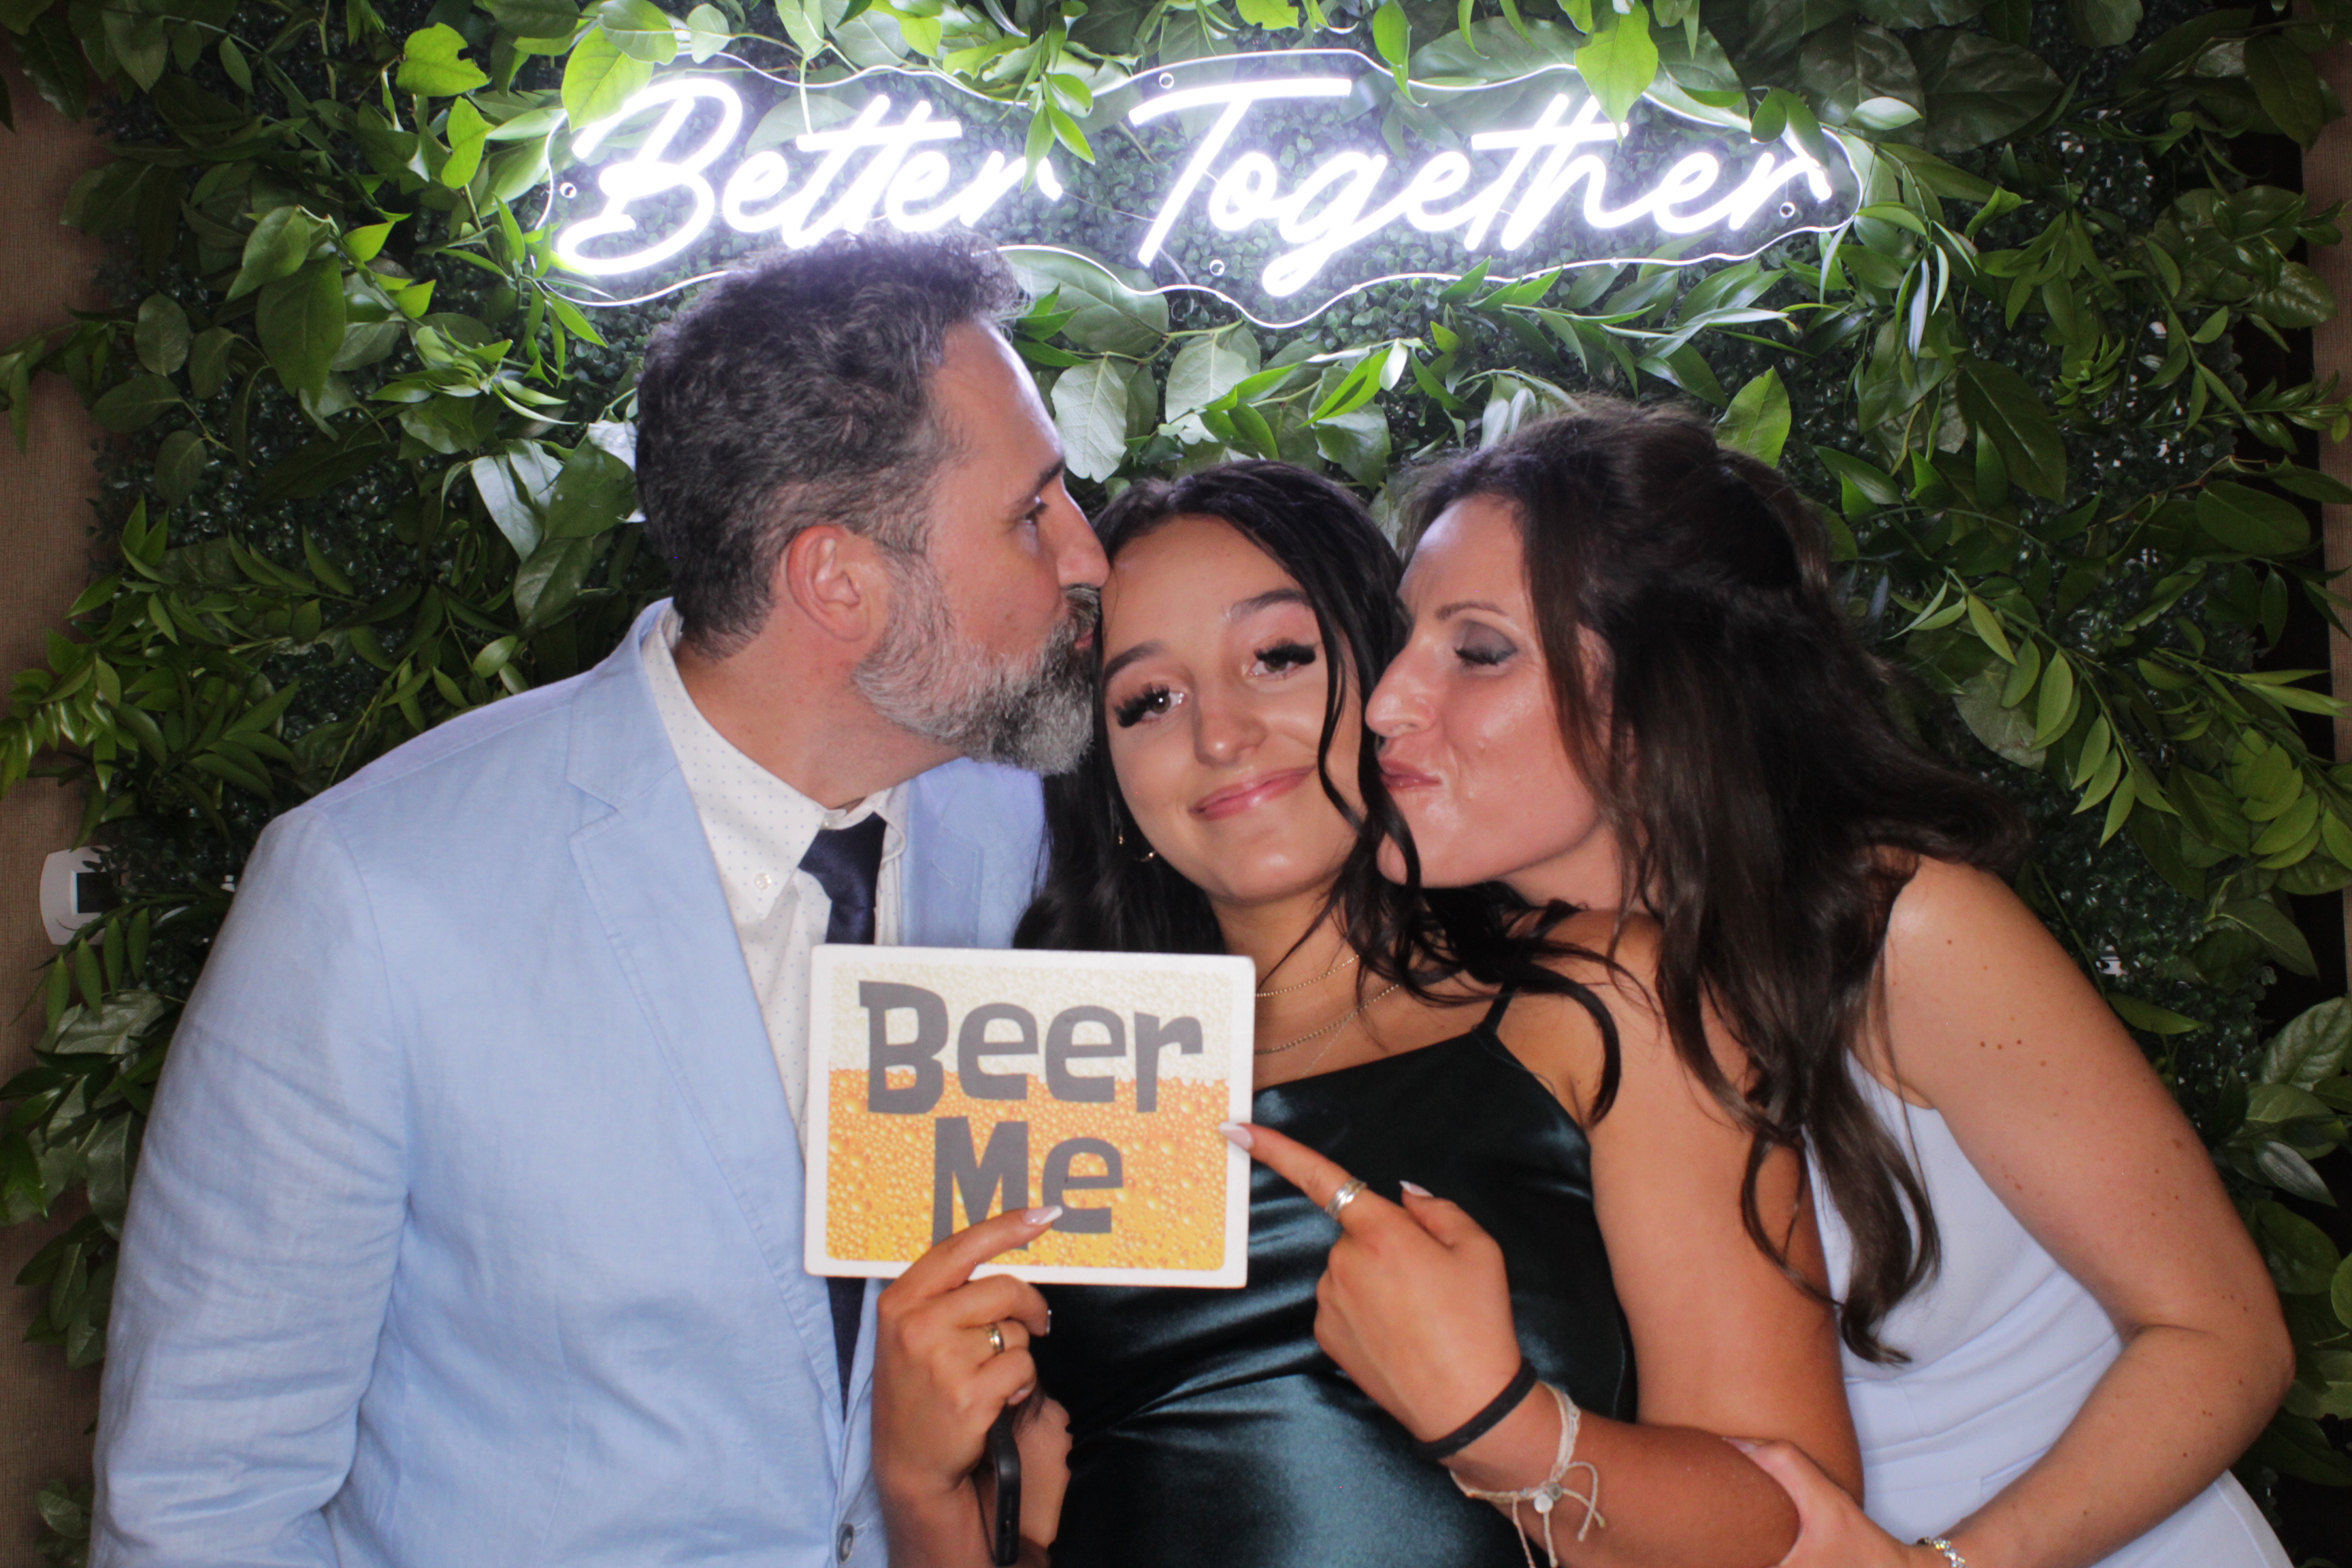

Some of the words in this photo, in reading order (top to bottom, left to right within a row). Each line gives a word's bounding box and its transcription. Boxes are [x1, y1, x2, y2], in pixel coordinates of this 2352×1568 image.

[557, 77, 1062, 272] Better
[1128, 78, 1833, 297] Together
[859, 980, 1203, 1115] Beer
[932, 1116, 1124, 1251] Me
